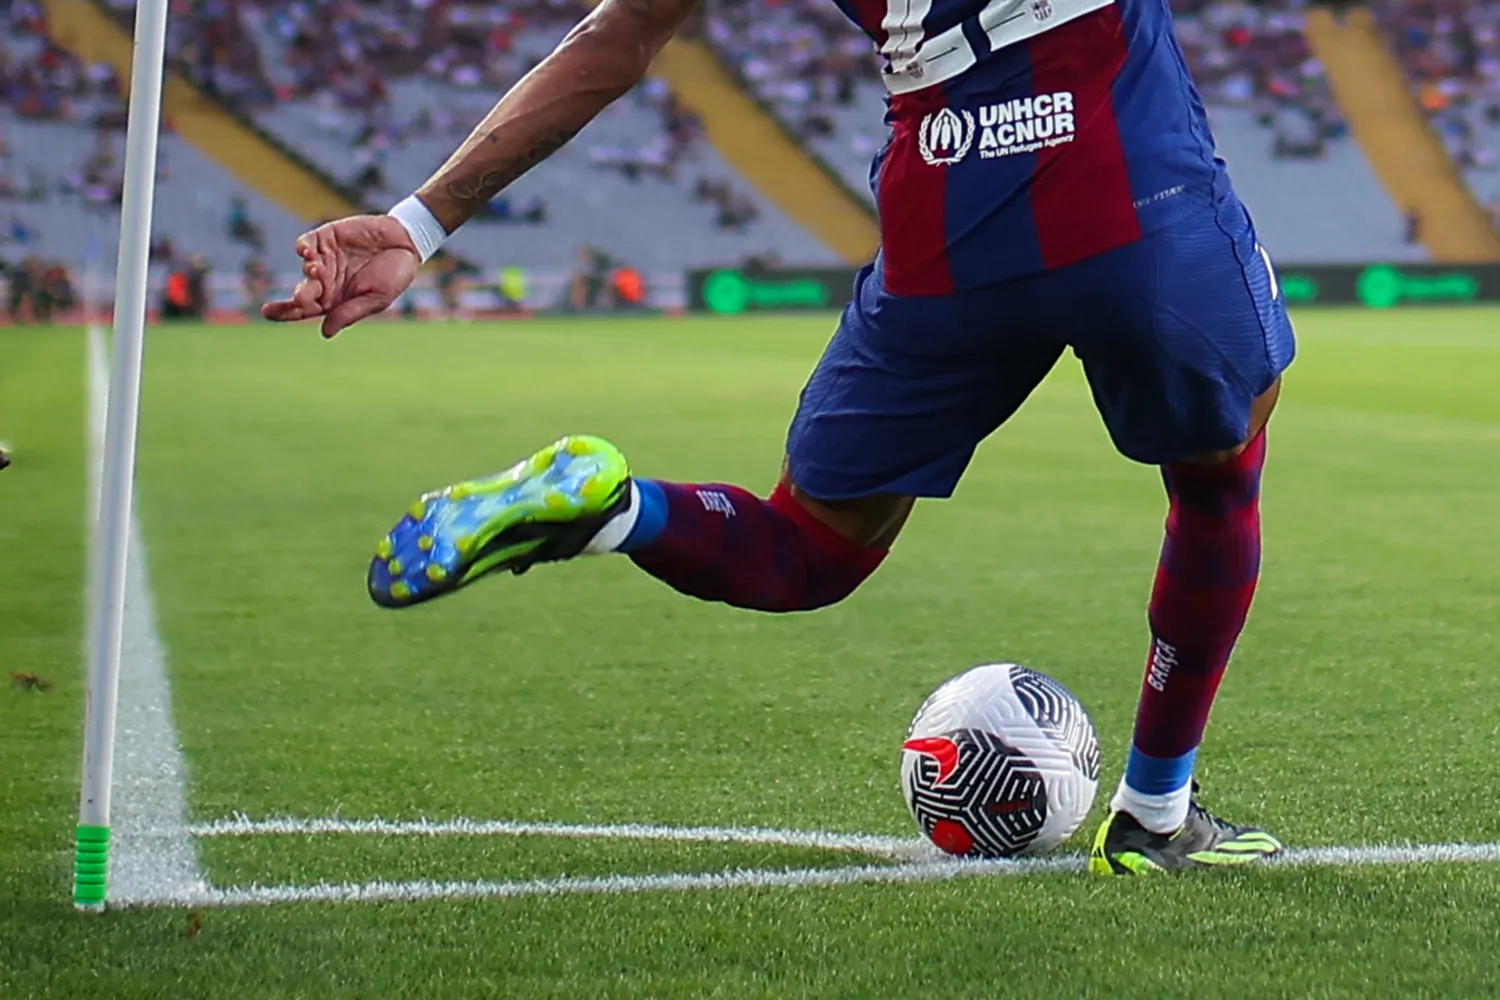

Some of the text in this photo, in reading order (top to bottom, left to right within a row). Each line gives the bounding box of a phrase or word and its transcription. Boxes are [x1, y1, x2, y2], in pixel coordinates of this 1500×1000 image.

[979, 91, 1074, 127] UNHCR
[978, 113, 1075, 149] ACNUR
[980, 149, 995, 159] The
[1010, 141, 1043, 154] Refugee
[1044, 134, 1075, 147] Agency
[1147, 637, 1178, 692] BARÇA
